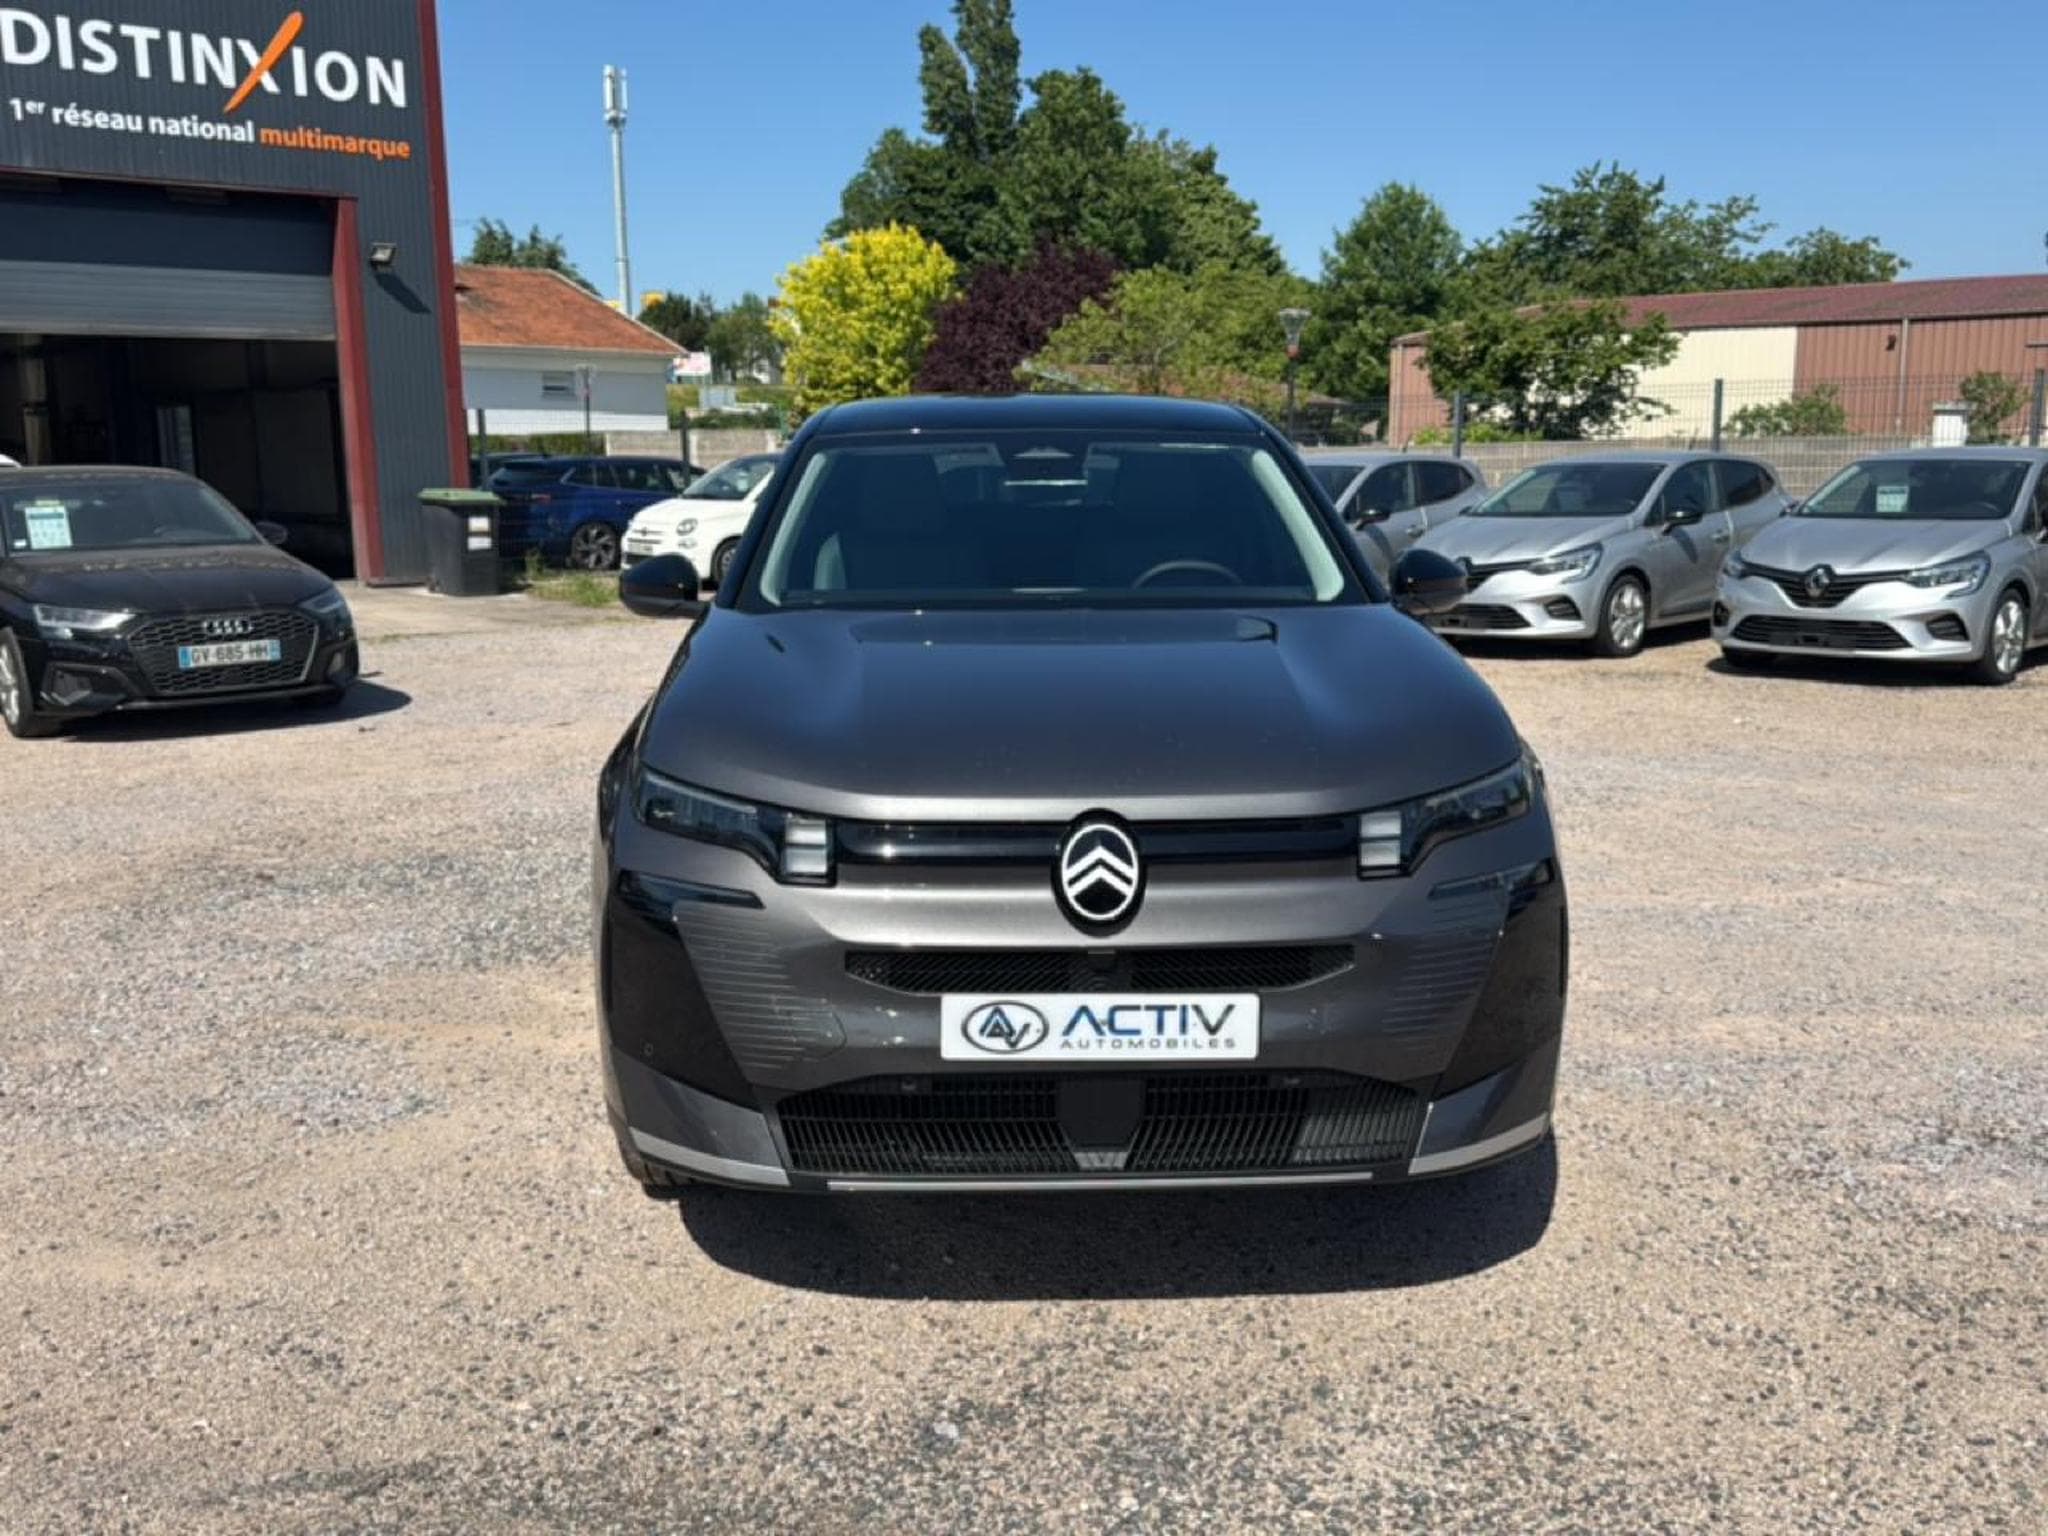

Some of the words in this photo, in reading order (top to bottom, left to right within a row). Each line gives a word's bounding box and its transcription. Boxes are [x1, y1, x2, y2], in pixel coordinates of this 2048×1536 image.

[0, 8, 408, 113] DISTINXION
[9, 97, 46, 121] 1er
[52, 102, 143, 132] réseau
[148, 115, 255, 143] national
[259, 126, 411, 160] multimarque
[1060, 1037, 1236, 1049] AUTOMOBILES
[1061, 1004, 1236, 1036] ACTIV
